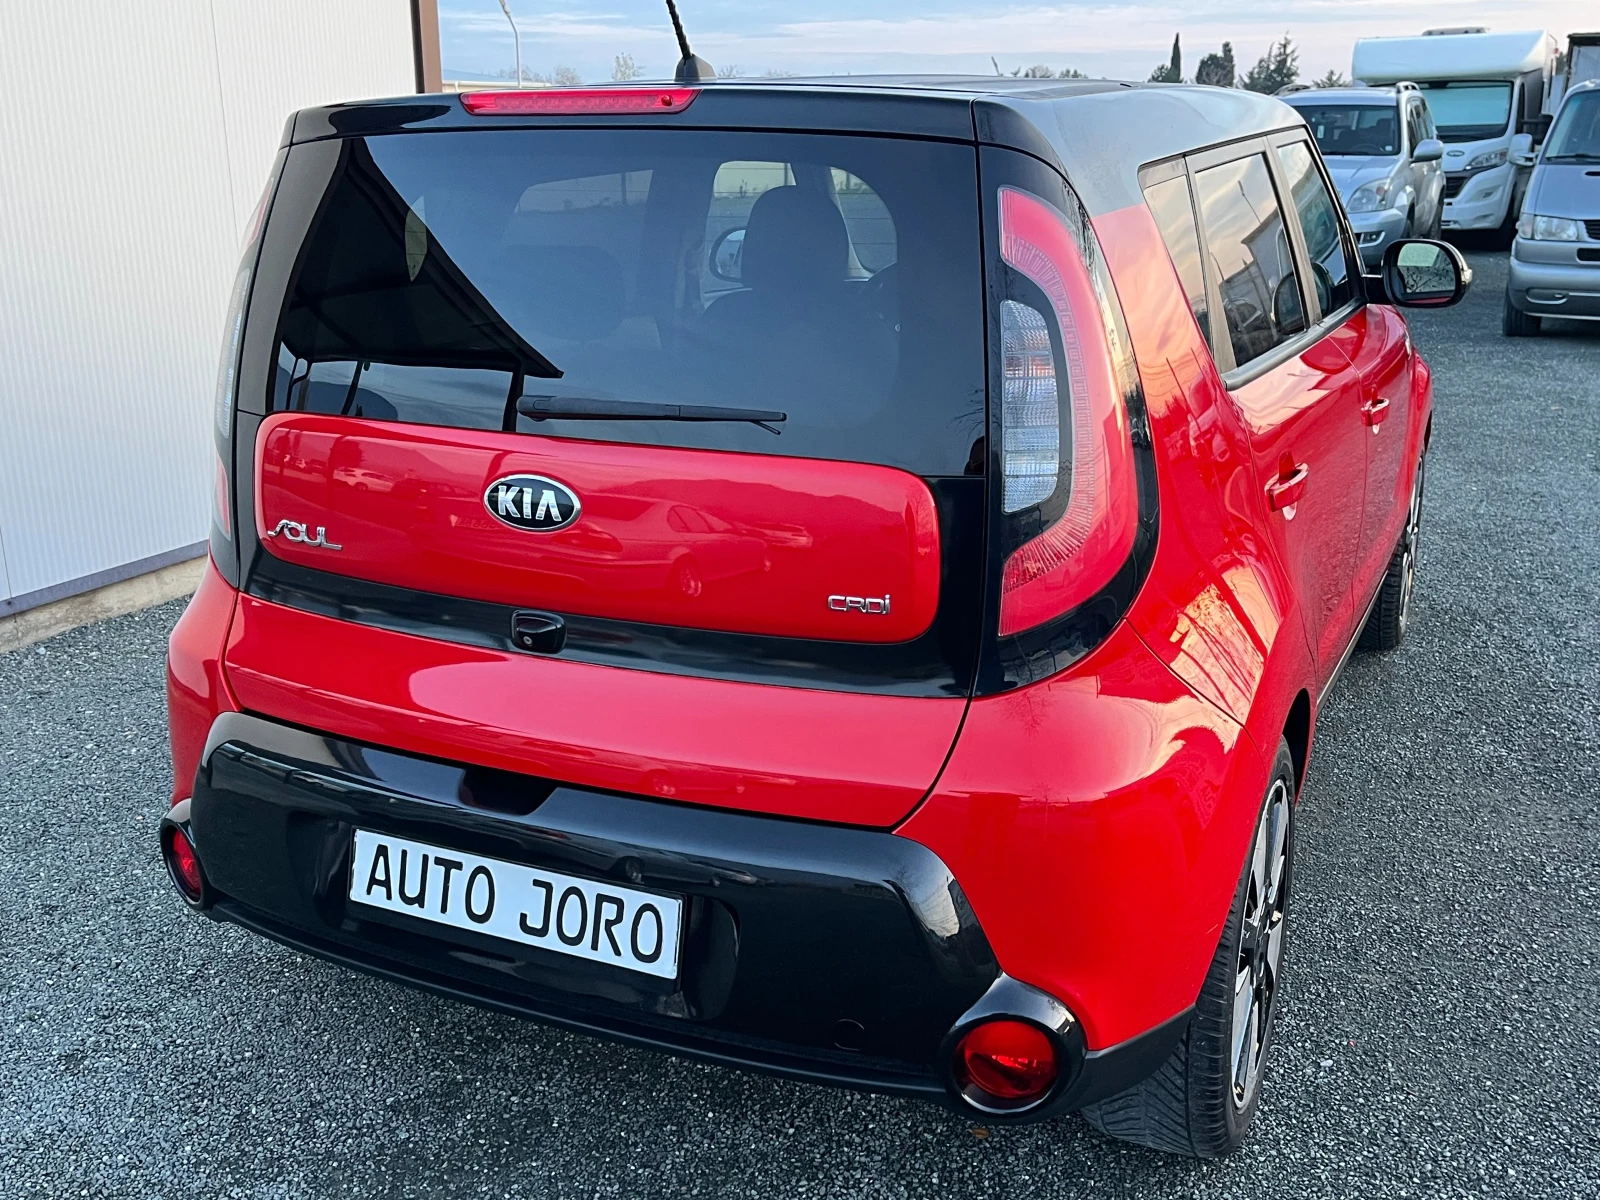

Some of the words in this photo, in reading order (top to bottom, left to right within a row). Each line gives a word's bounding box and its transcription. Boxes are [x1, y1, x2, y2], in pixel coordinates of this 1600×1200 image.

[497, 485, 563, 522] KIA
[827, 593, 891, 615] CRDi
[365, 843, 496, 924] AUTO
[518, 878, 663, 963] JORO
